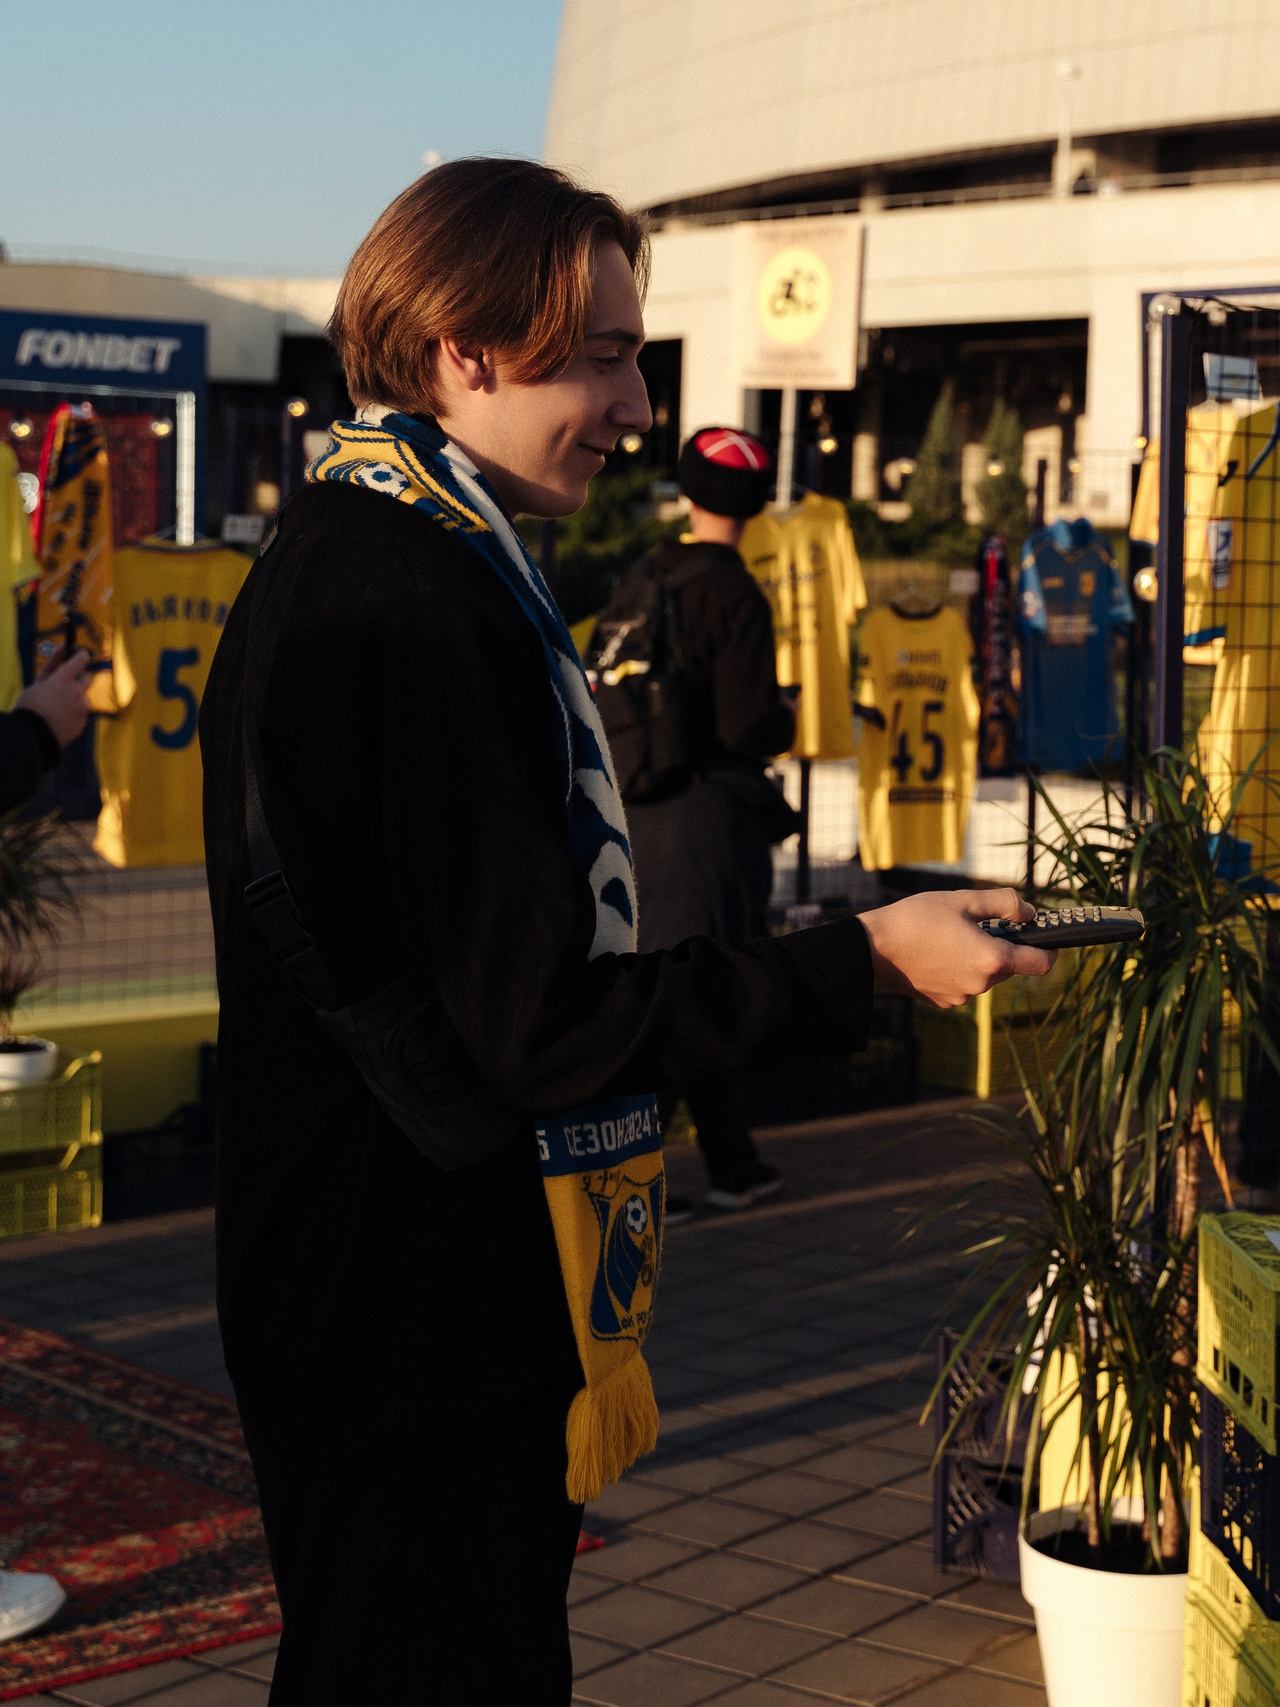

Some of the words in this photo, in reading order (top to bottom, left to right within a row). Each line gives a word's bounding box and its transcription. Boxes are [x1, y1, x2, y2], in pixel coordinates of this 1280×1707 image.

[15, 328, 182, 375] FONBET
[152, 647, 199, 750] 5
[890, 700, 945, 783] 45
[563, 1119, 624, 1156] СЕЗОН
